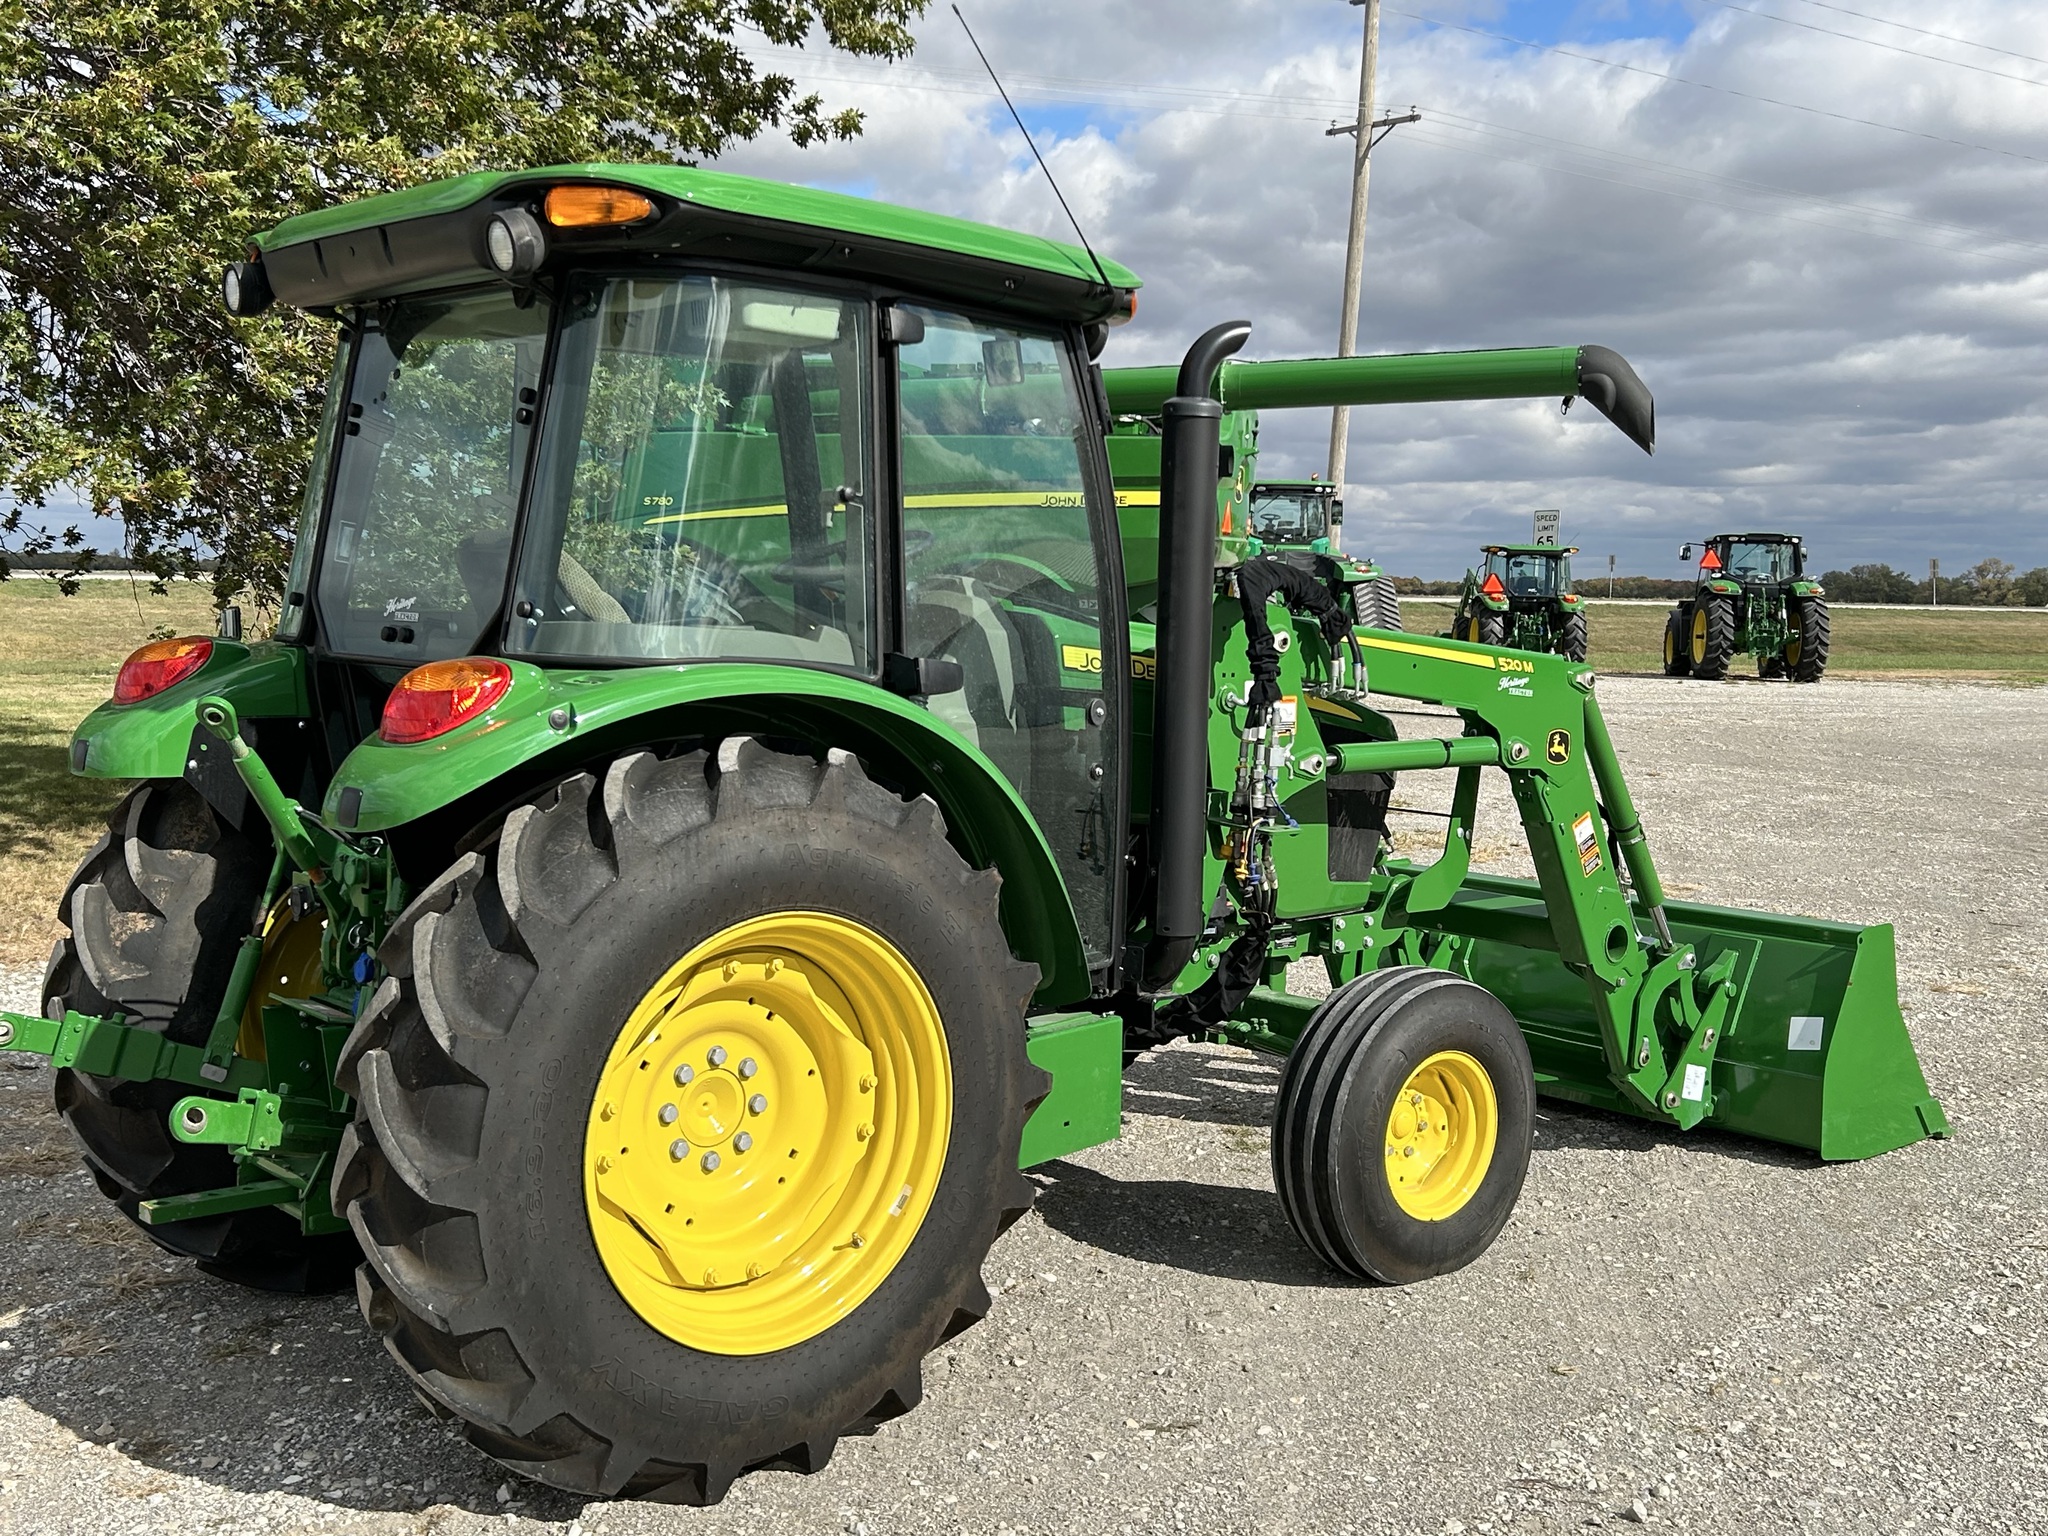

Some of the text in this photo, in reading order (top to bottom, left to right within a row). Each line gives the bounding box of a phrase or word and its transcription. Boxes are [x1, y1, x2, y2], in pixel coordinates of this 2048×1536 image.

[643, 496, 674, 506] S780
[1041, 494, 1077, 506] JOHN
[1536, 514, 1558, 522] SPEED
[1537, 524, 1555, 532] LIMIT
[1537, 535, 1554, 546] 65
[525, 1058, 562, 1240] 16.9-30
[589, 1355, 791, 1426] GALAXY
